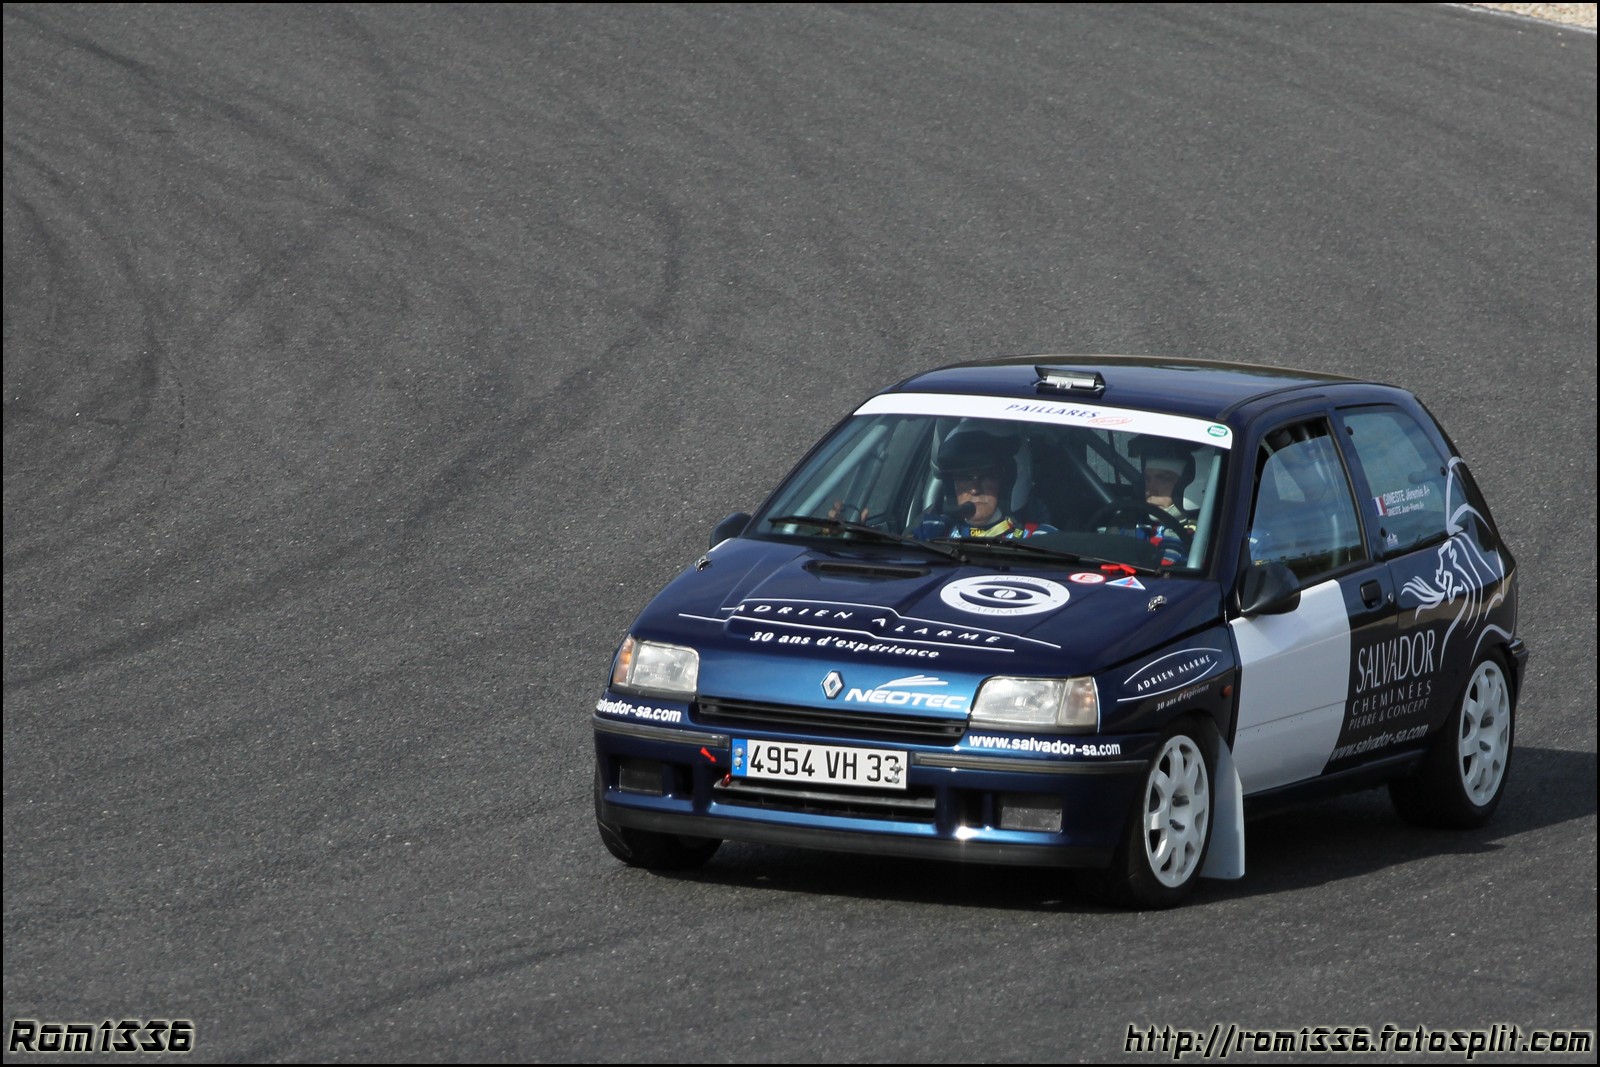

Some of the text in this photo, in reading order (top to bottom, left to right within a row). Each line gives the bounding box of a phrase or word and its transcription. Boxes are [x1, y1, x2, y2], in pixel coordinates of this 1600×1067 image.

[1006, 403, 1101, 418] PAILLARES
[1383, 490, 1405, 505] GINESTE
[735, 604, 1001, 643] ADRIEN ALARME
[750, 631, 940, 659] 30 ans d'expérience
[1356, 629, 1435, 693] SALVADOR
[1137, 655, 1211, 692] ADRIEN ALARME
[845, 688, 968, 709] NEOTEC
[1156, 701, 1165, 712] 30
[1166, 698, 1178, 709] ans
[1348, 697, 1430, 731] PIERRE & CONCEPT
[1352, 680, 1432, 716] CHEMINÉES
[969, 735, 1121, 757] www.salvador-sa.com
[1330, 724, 1429, 761] www.salvador-sa.com
[749, 744, 901, 783] 4954 VH 33
